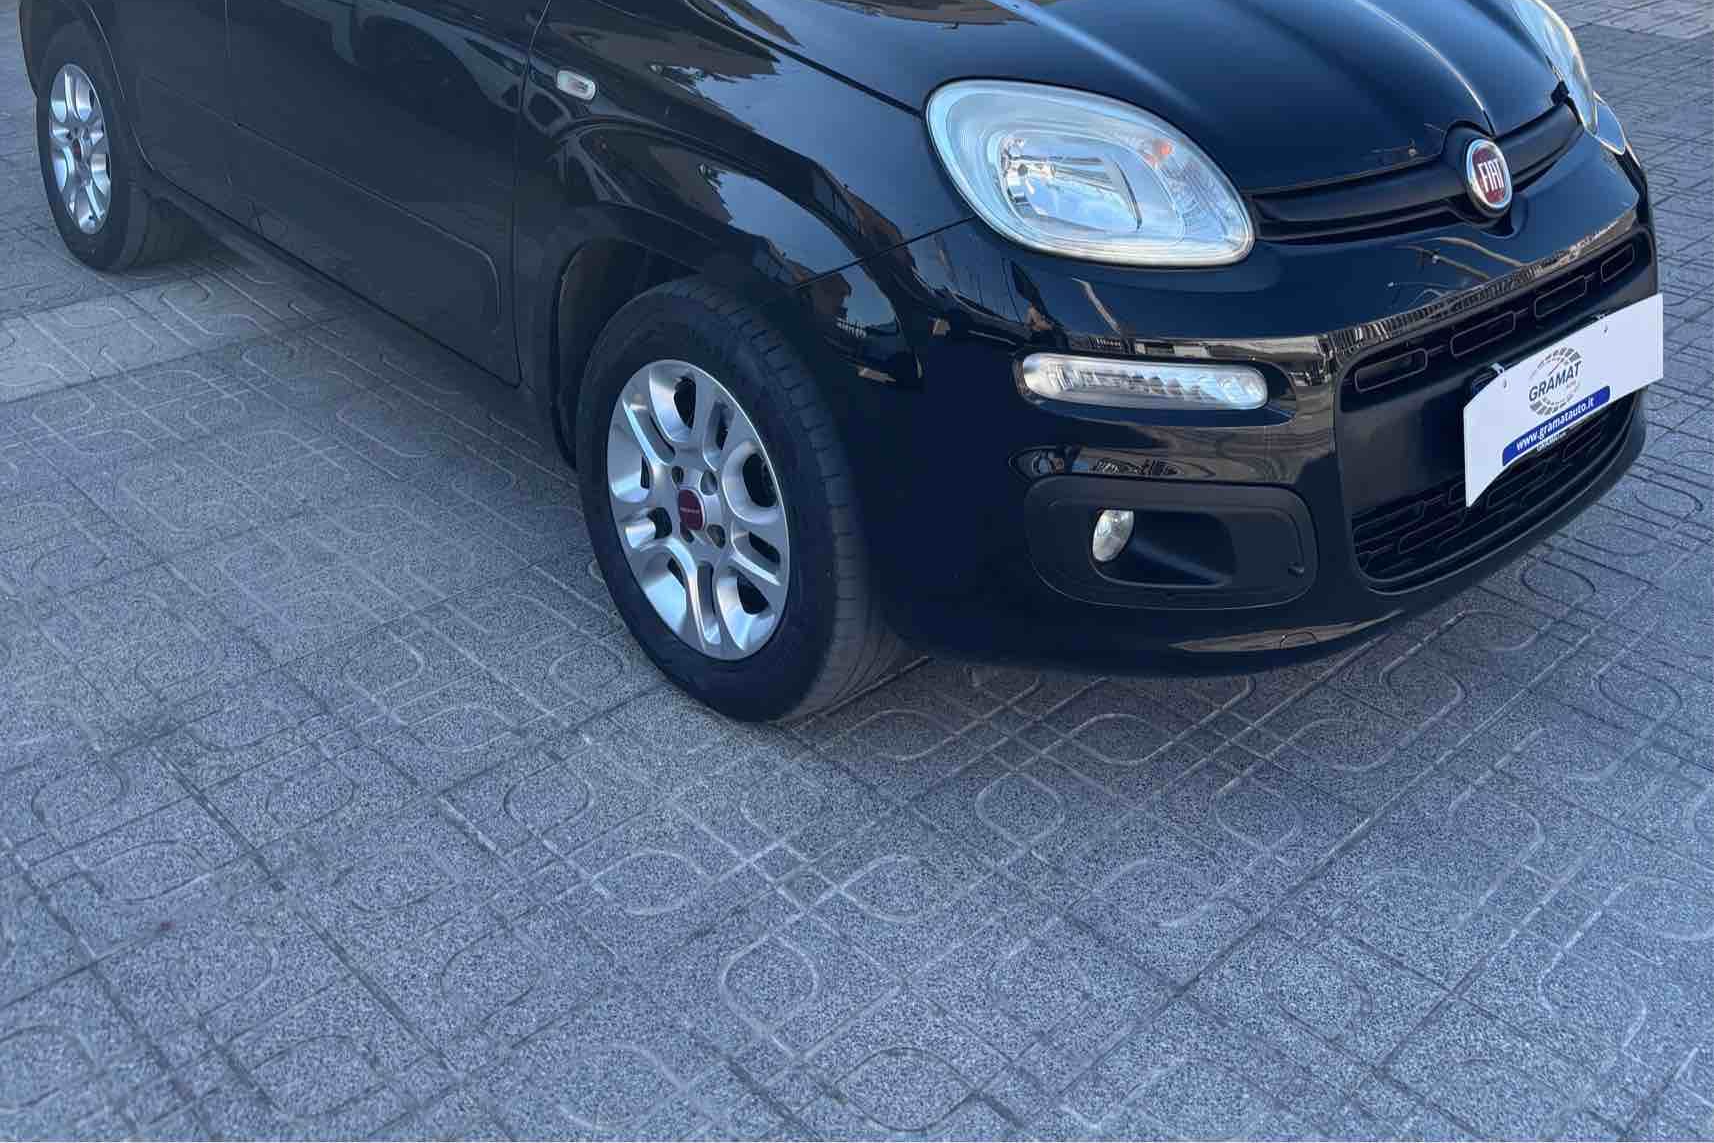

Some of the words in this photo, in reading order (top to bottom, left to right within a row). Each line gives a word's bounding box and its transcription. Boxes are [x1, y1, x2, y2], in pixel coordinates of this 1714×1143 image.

[1477, 158, 1505, 193] FIAT
[1528, 360, 1582, 402] GRAMAT
[1516, 397, 1595, 451] www.gramatauto.it
